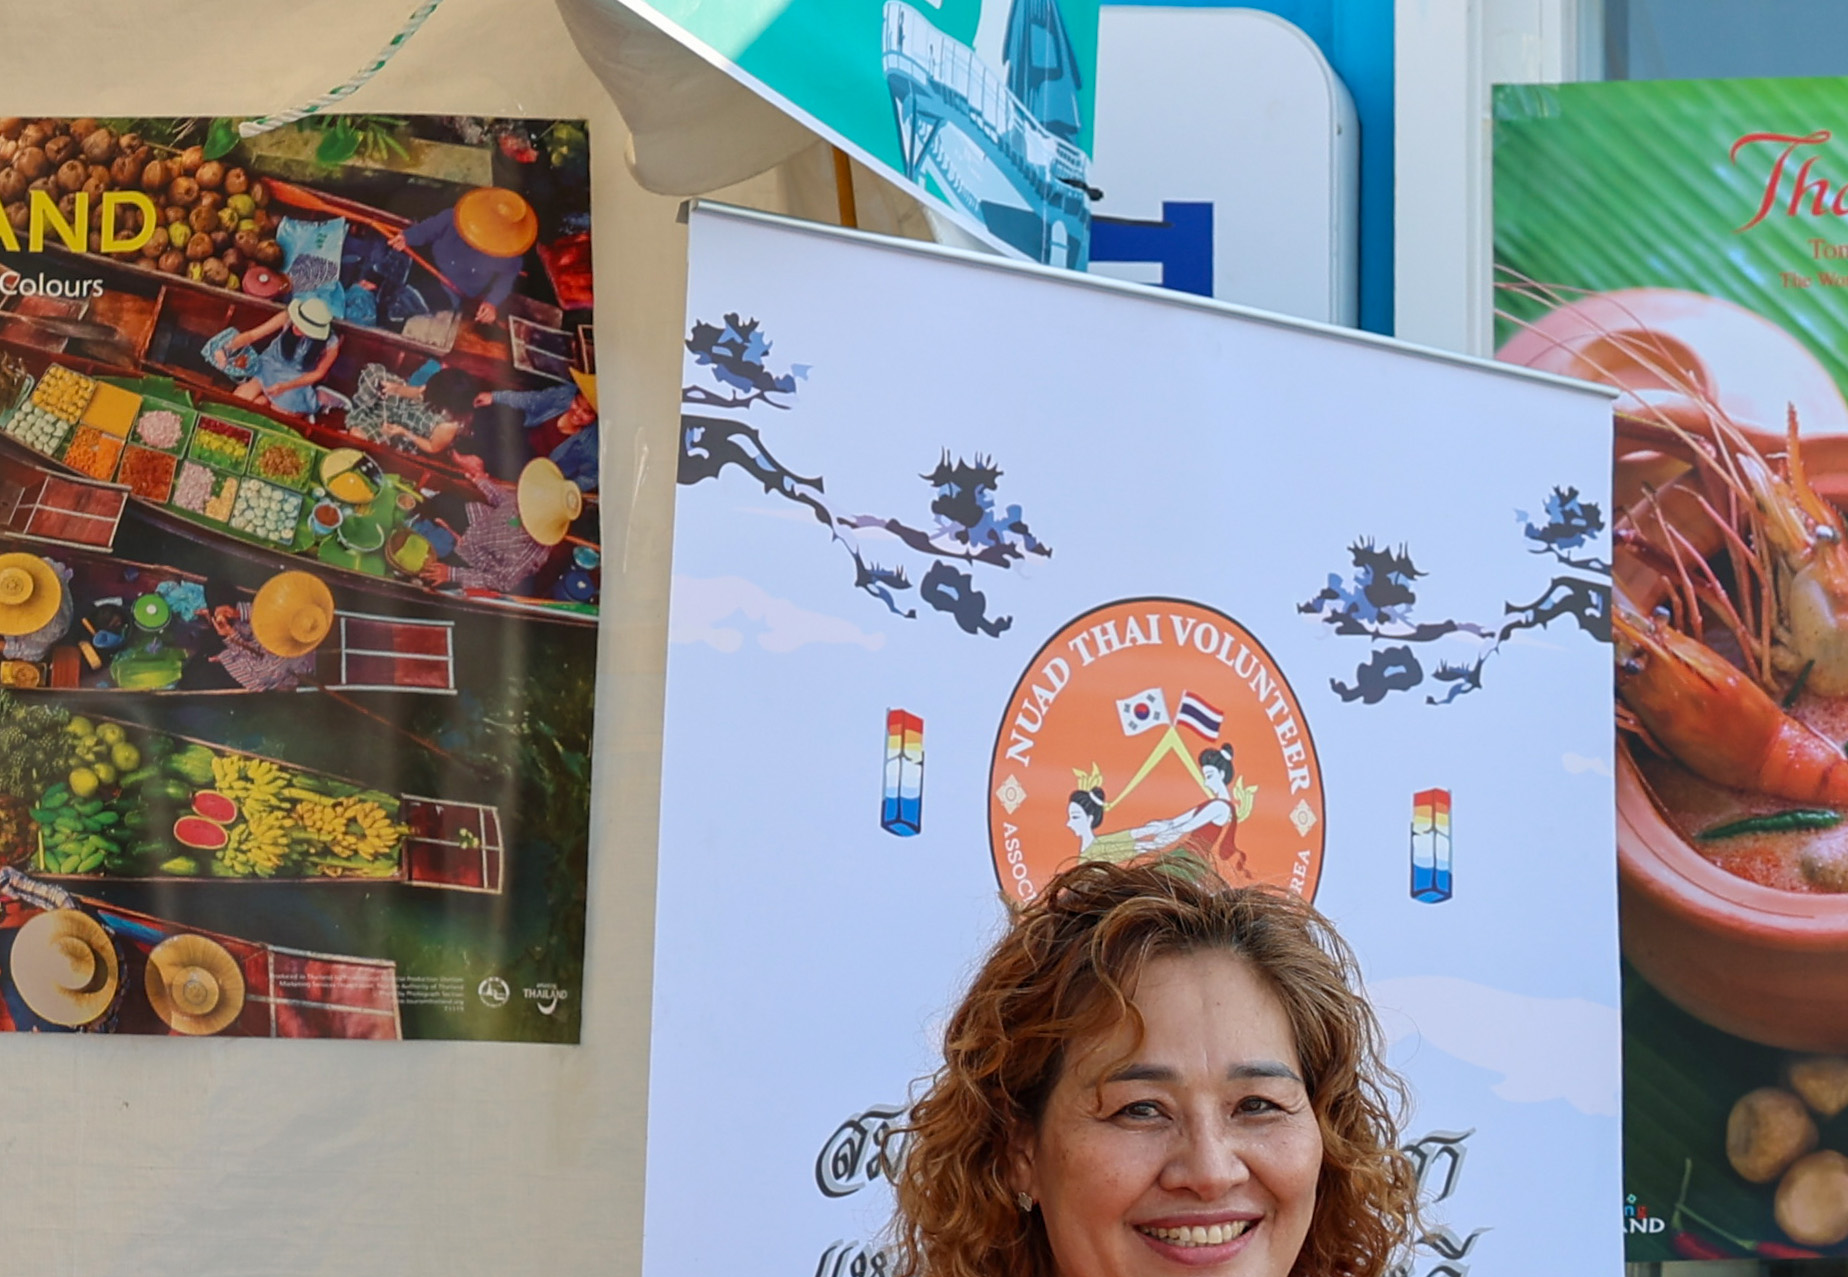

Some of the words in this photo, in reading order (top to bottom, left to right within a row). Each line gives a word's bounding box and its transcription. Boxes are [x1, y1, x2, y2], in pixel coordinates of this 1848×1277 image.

[0, 271, 104, 299] Colours
[1779, 271, 1812, 289] The
[1005, 657, 1071, 767] NUAD
[1068, 614, 1162, 667] THAI
[1169, 614, 1311, 795] VOLUNTEER
[524, 988, 568, 999] THAILAND
